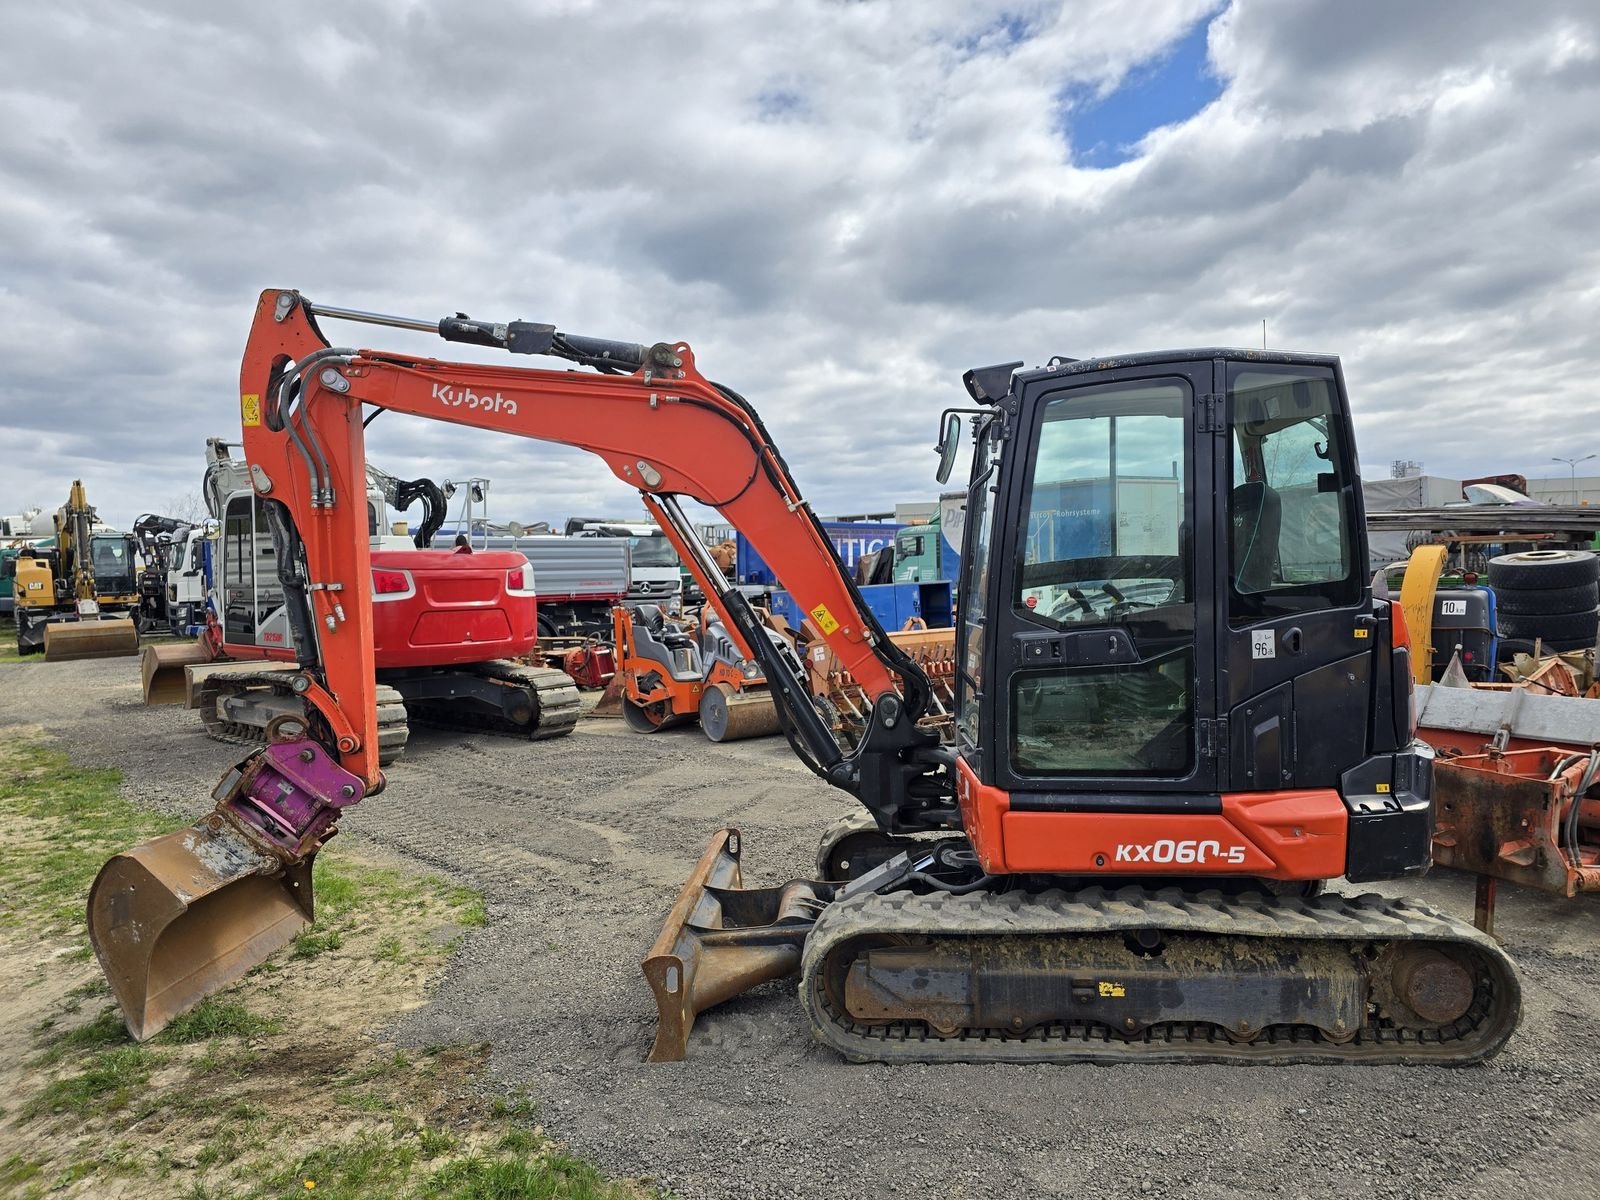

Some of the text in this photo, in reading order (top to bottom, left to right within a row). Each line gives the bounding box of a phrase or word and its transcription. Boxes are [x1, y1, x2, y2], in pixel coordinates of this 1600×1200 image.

[432, 383, 518, 415] Kubota
[1443, 602, 1455, 613] 10
[1254, 642, 1268, 656] 96
[1115, 839, 1246, 864] KX060-5
